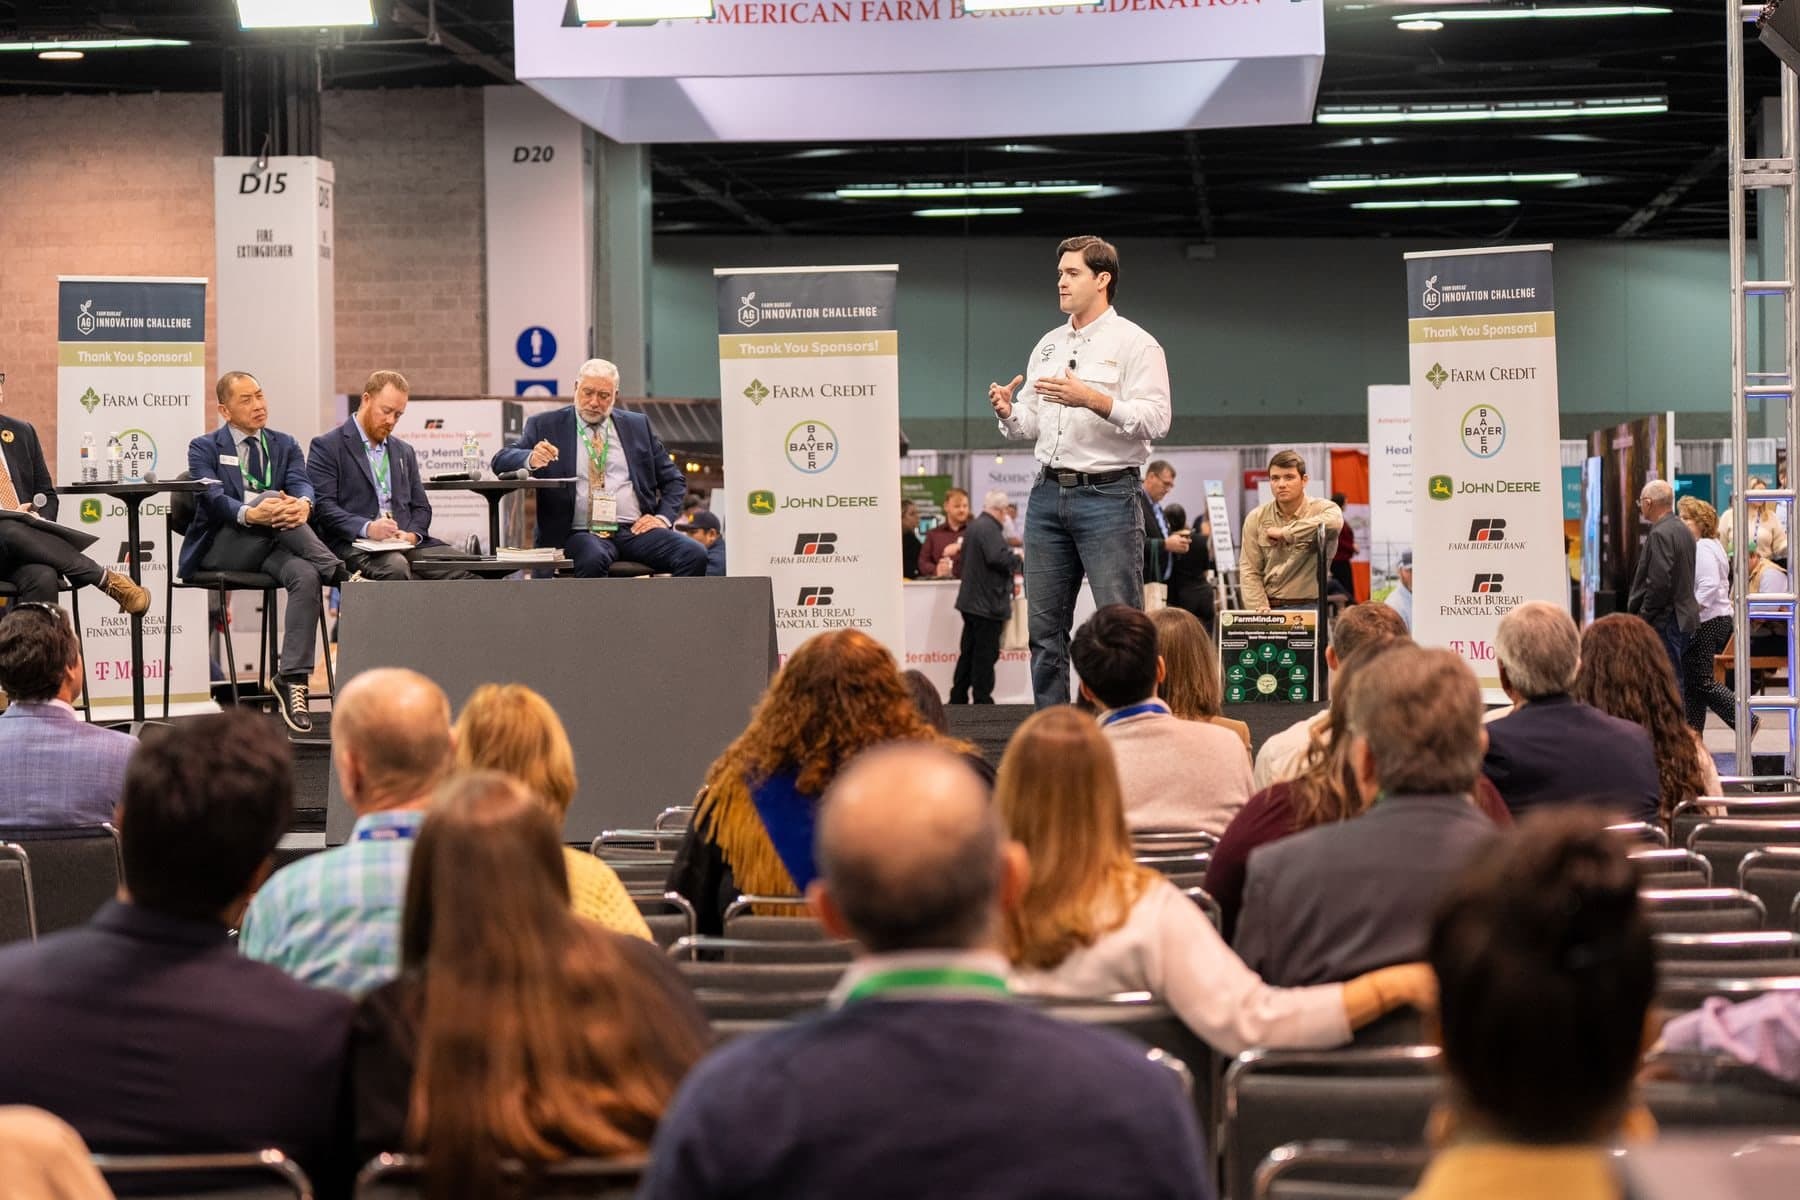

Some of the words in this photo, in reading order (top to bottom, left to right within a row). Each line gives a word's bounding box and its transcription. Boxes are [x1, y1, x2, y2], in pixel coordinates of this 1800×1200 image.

[695, 1, 853, 25] MERICAN
[861, 0, 941, 22] FARM
[513, 146, 554, 163] D20
[239, 173, 288, 194] D15
[1442, 290, 1489, 303] INNOVATION
[1491, 287, 1536, 300] CHALLENGE
[761, 308, 819, 319] INNOVATION
[822, 306, 877, 318] CHALLENGE
[96, 317, 144, 329] INNOVATION
[146, 317, 192, 329] CHALLENGE
[1424, 325, 1458, 338] Thank
[1460, 325, 1480, 336] You
[1483, 322, 1537, 338] Sponsors!
[739, 342, 782, 355] Thank
[784, 342, 809, 353] You
[812, 340, 879, 356] Sponsors!
[78, 351, 112, 362] Thank
[113, 351, 135, 362] You
[137, 351, 193, 365] Sponsors!
[1451, 368, 1486, 382] FARM
[1490, 367, 1537, 381] CREDIT
[773, 384, 814, 398] FARM
[820, 383, 876, 397] CREDIT
[103, 392, 138, 407] FARM
[143, 392, 191, 407] CREDIT
[1465, 427, 1502, 436] BAYER
[789, 442, 834, 452] BAYER
[1385, 445, 1412, 456] Heal
[124, 451, 154, 460] AYER
[1457, 481, 1494, 494] JOHN
[1497, 480, 1541, 493] DEERE
[780, 496, 823, 509] JOHN
[827, 495, 879, 507] DEERE
[1471, 542, 1503, 550] BUREAU
[1504, 541, 1528, 550] BANK
[770, 556, 795, 564] FARM
[797, 555, 833, 564] BUREAU
[835, 554, 861, 562] BANK
[1454, 594, 1482, 605] FARM
[1485, 594, 1524, 605] BUREAU
[777, 608, 808, 618] FARM
[812, 607, 856, 617] BUREAU
[1440, 605, 1492, 616] FINANCIAL
[101, 616, 128, 627] FARM
[823, 618, 873, 627] SERVICES
[1234, 615, 1286, 625] FarmMind.org
[86, 626, 131, 638] FINANCIA
